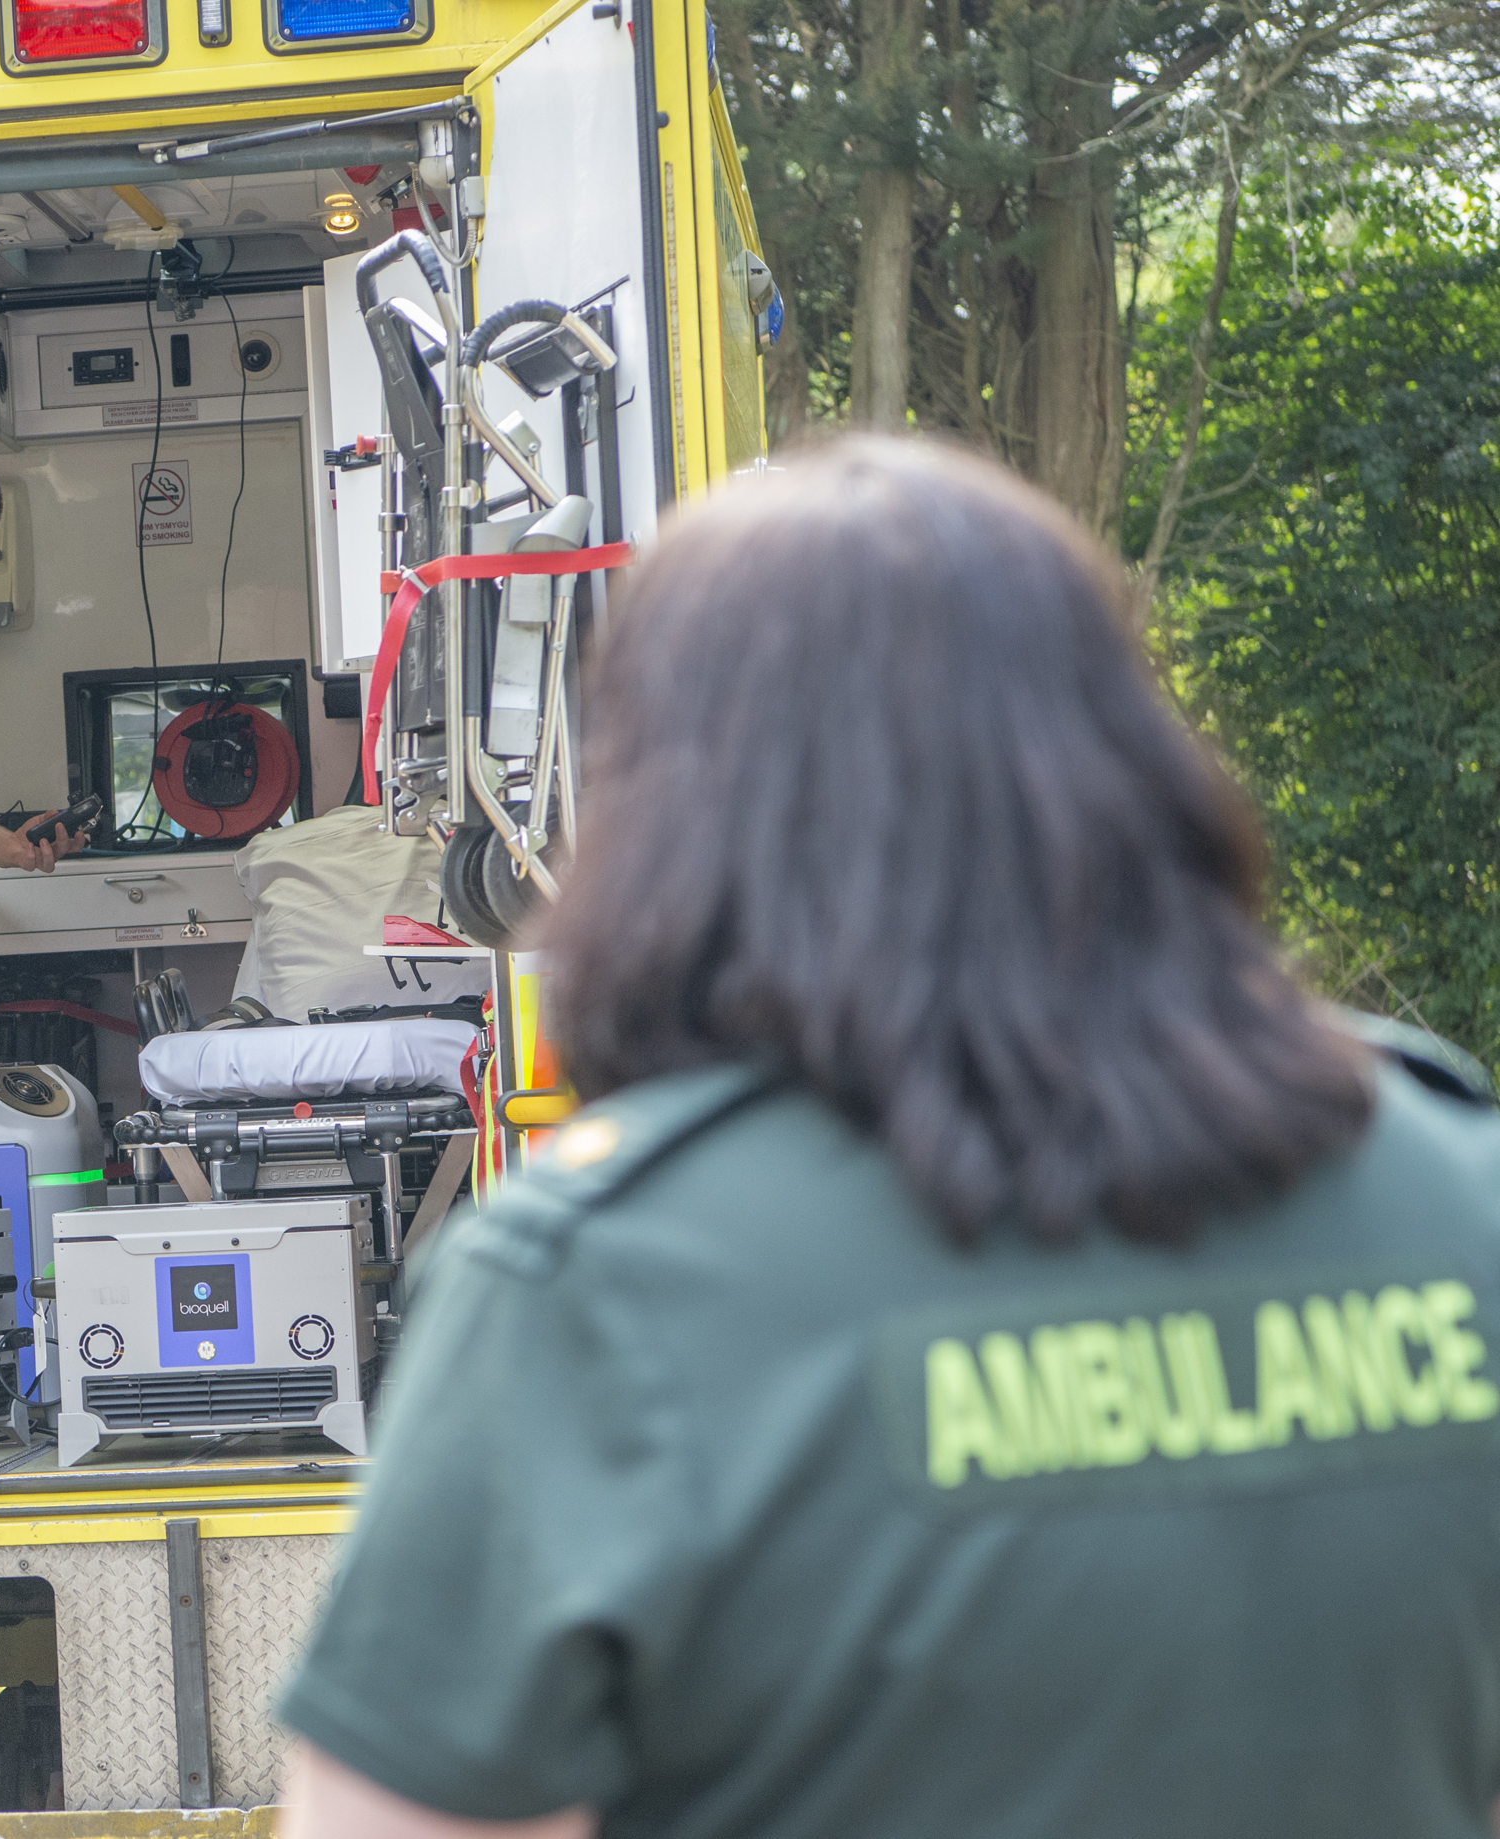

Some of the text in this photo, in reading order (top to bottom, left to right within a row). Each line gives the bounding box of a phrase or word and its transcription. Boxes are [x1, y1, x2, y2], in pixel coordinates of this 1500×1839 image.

[139, 521, 189, 531] IM YSMYGU
[152, 531, 190, 540] SMOKING
[286, 1167, 342, 1180] FERNO
[179, 1300, 230, 1317] bioquell
[924, 1279, 1500, 1490] AMBULANCE
